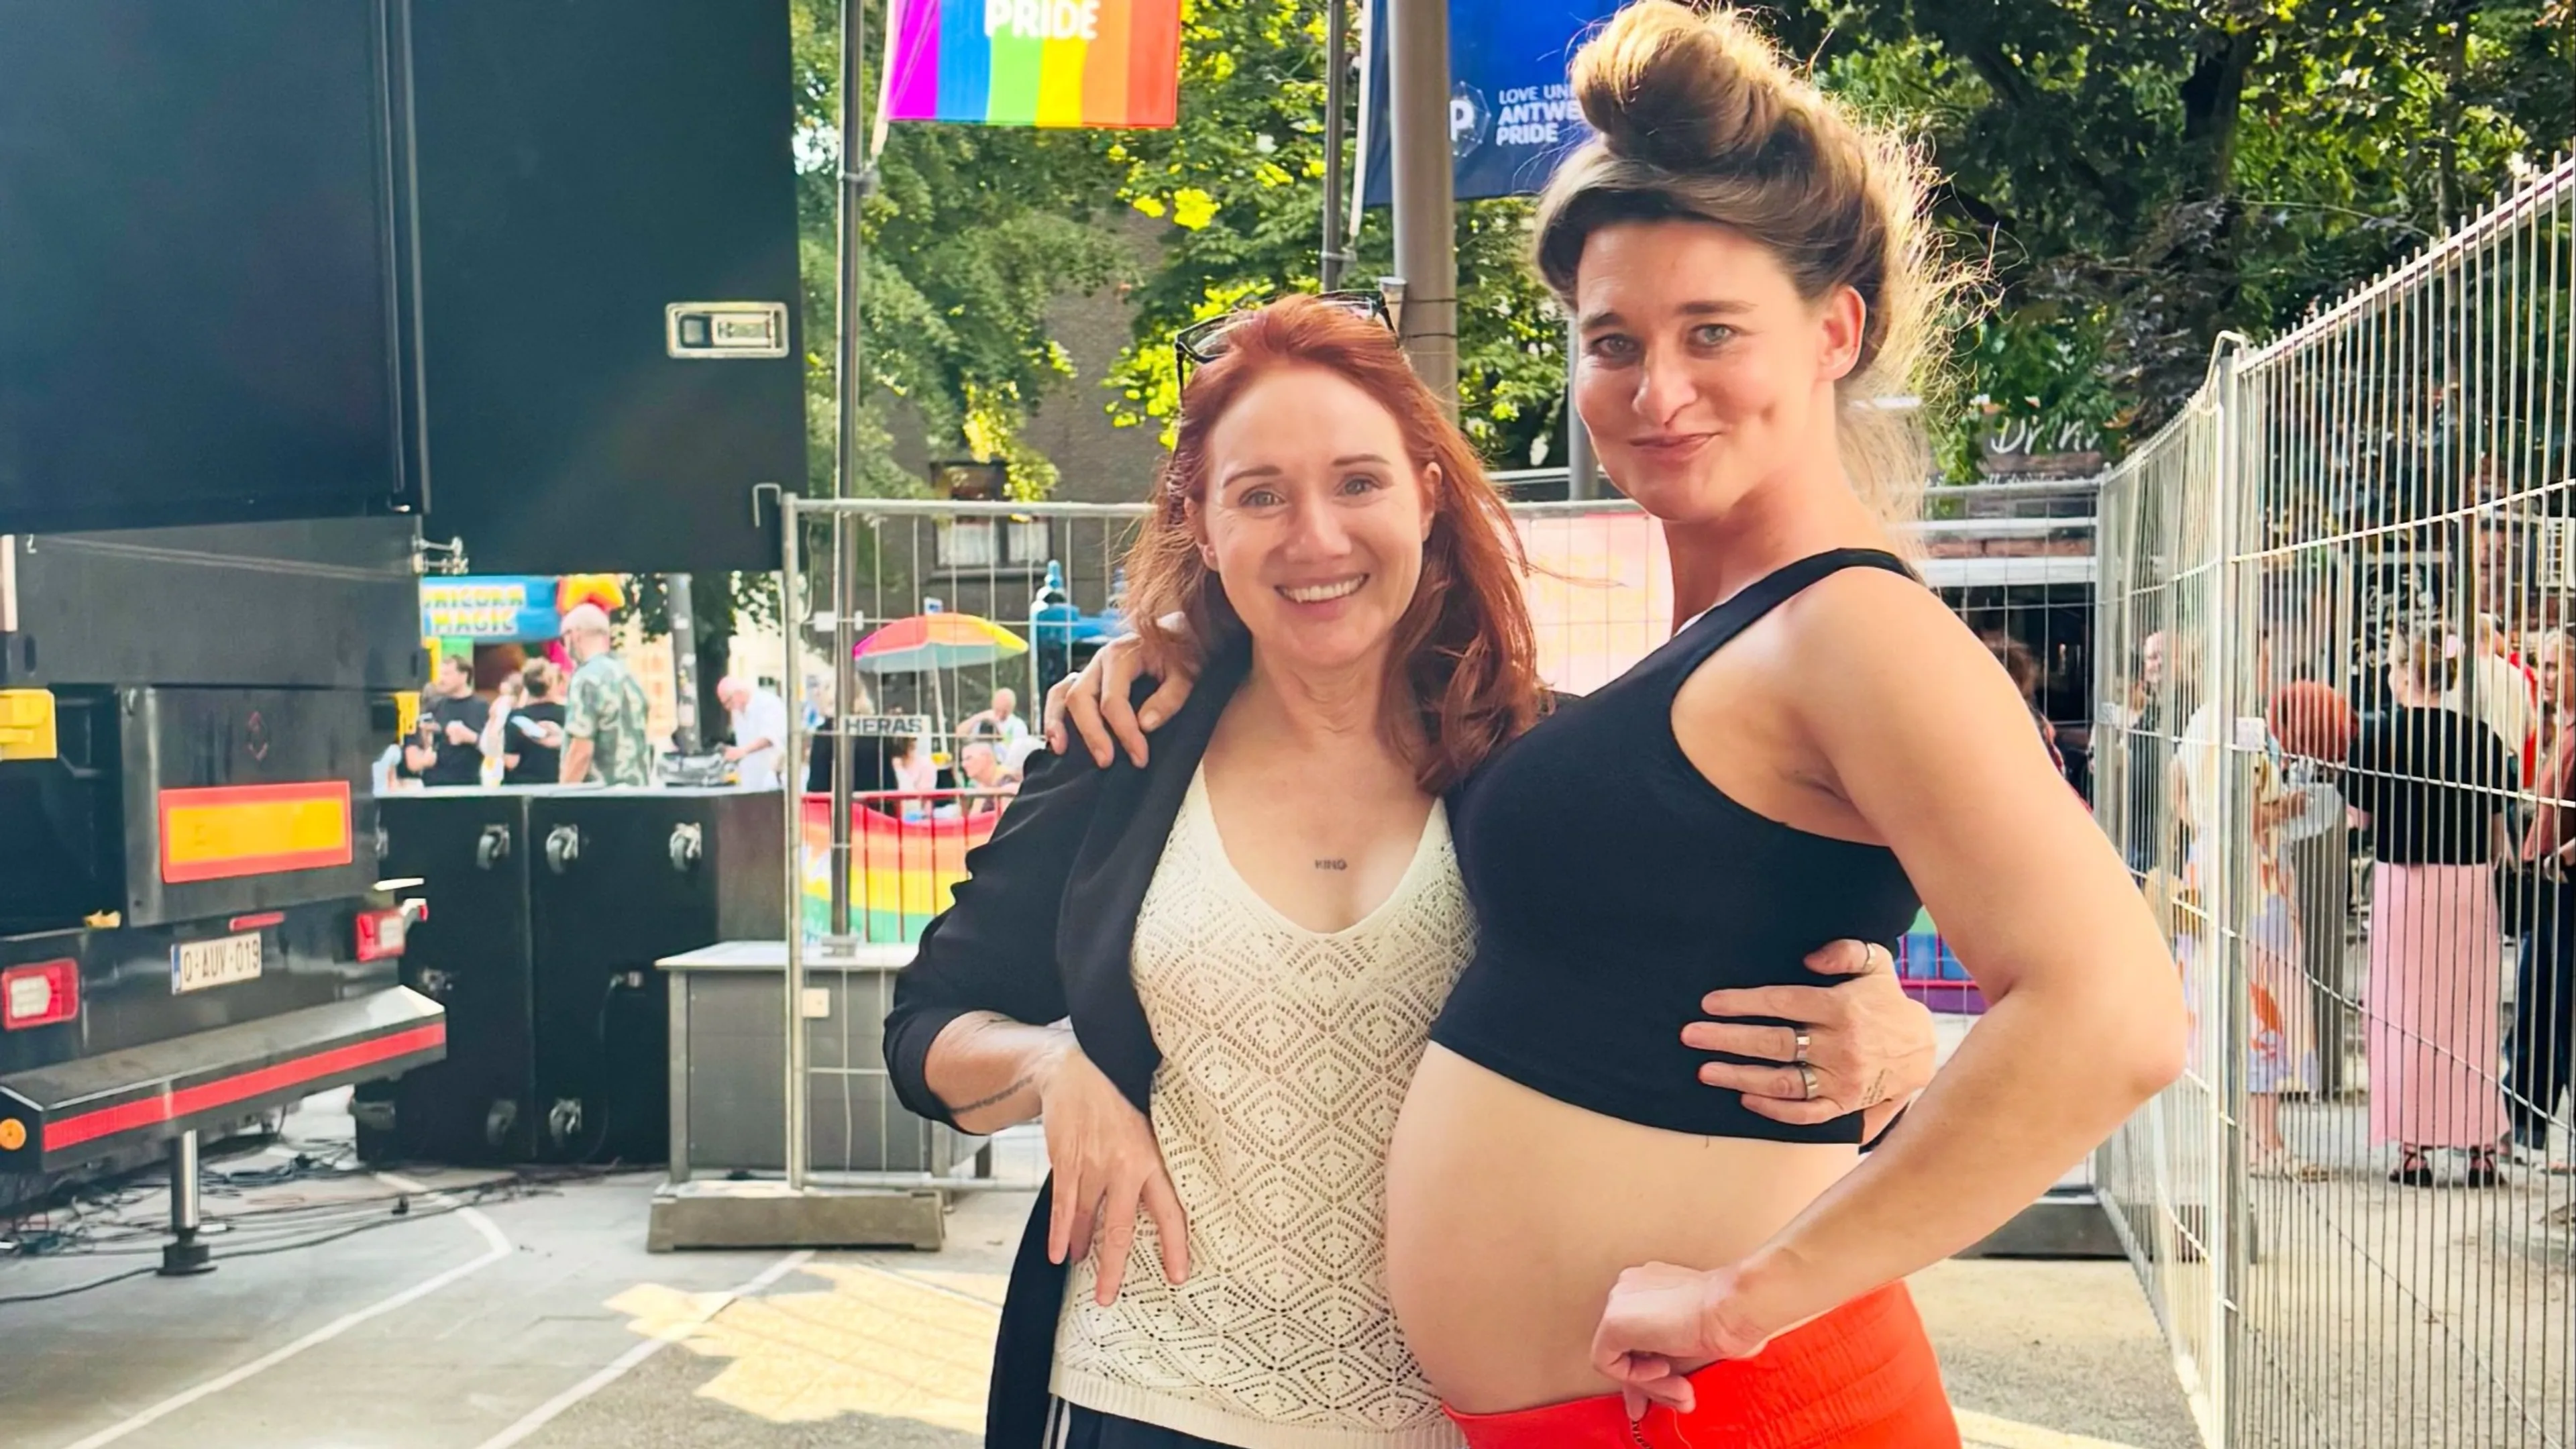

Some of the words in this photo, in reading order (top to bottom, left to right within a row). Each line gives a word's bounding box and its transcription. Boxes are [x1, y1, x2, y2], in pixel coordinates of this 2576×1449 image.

[984, 0, 1101, 40] PRIDE
[1499, 87, 1539, 105] LOVE
[1498, 101, 1585, 125] ANTWE
[1497, 122, 1559, 146] PRIDE
[845, 718, 922, 734] HERAS
